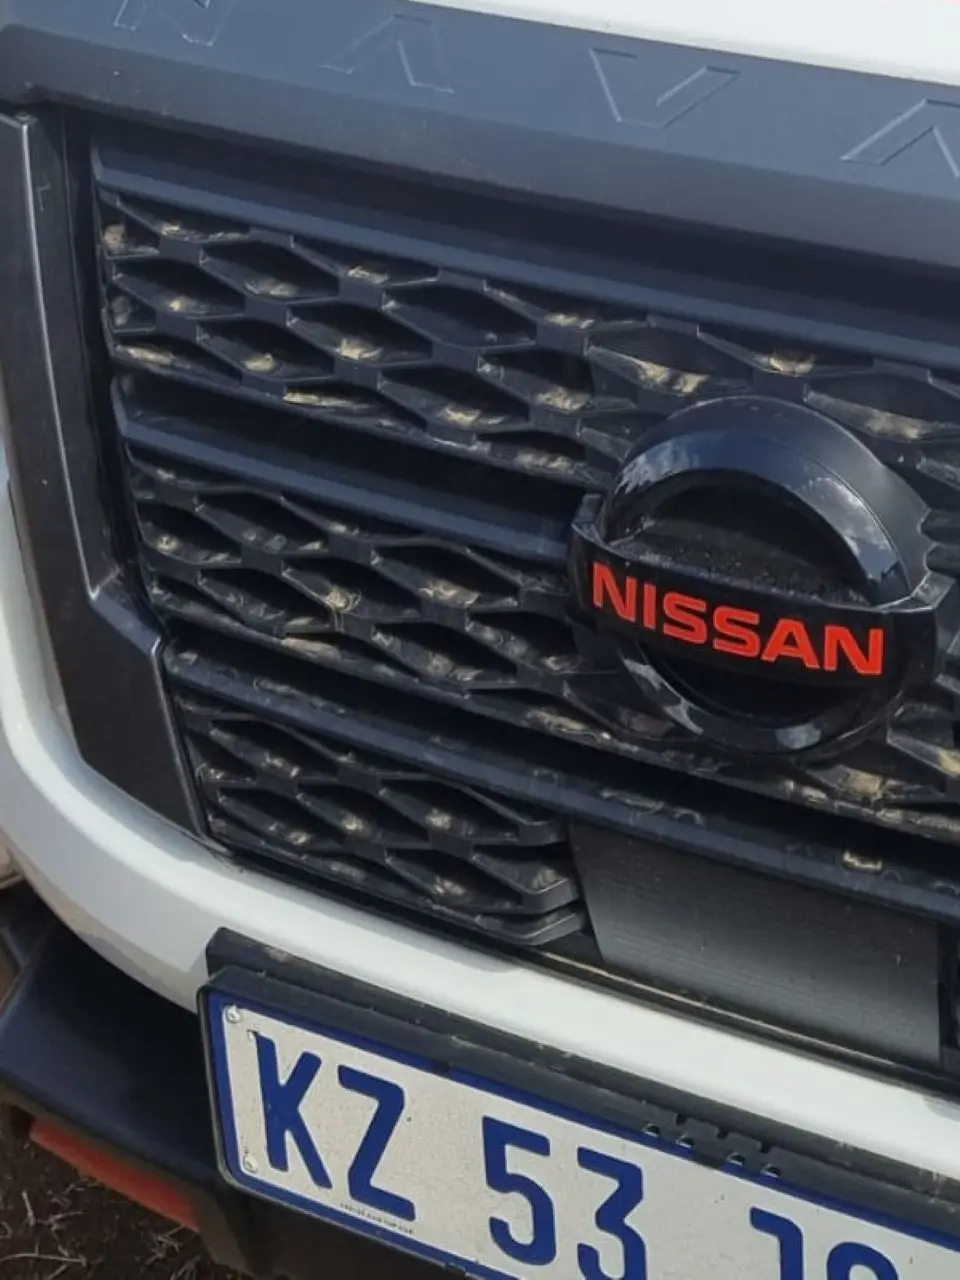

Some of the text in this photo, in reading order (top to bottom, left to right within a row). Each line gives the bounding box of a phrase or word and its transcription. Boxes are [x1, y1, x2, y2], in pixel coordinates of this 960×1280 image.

[591, 560, 885, 676] NISSAN
[253, 1029, 417, 1223] KZ
[481, 1115, 649, 1280] 53
